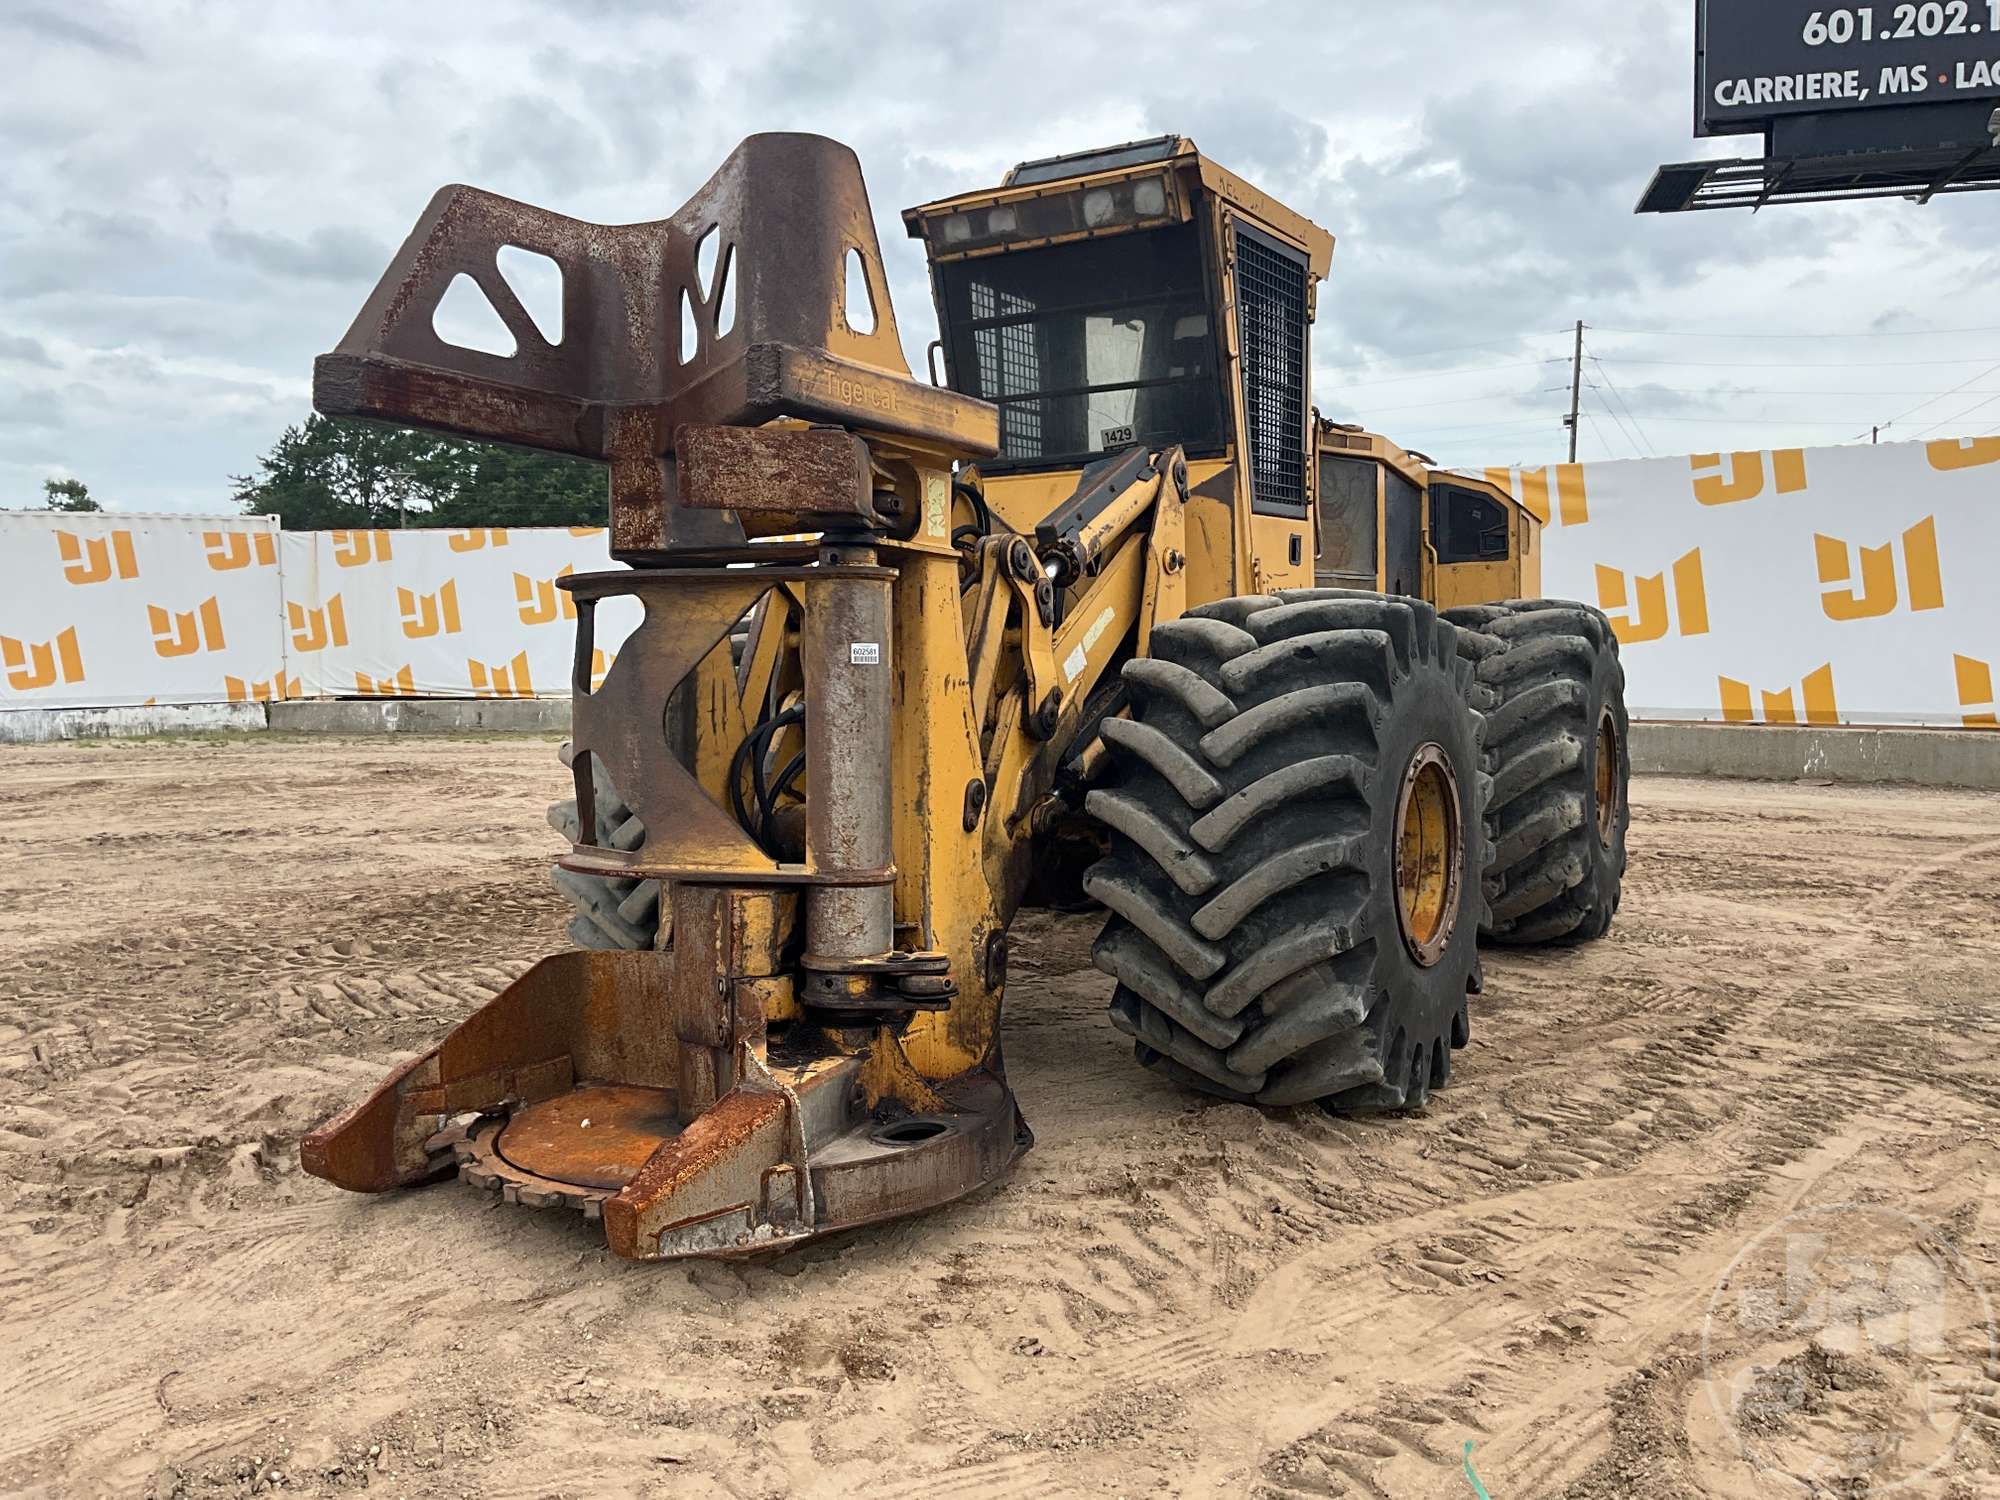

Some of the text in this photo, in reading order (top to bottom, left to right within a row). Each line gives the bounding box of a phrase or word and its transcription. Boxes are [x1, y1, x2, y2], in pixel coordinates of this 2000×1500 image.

[1715, 70, 1869, 105] CARRIERE,
[1879, 65, 1928, 95] MS
[824, 369, 899, 411] Tigercat
[1104, 427, 1132, 444] 1429
